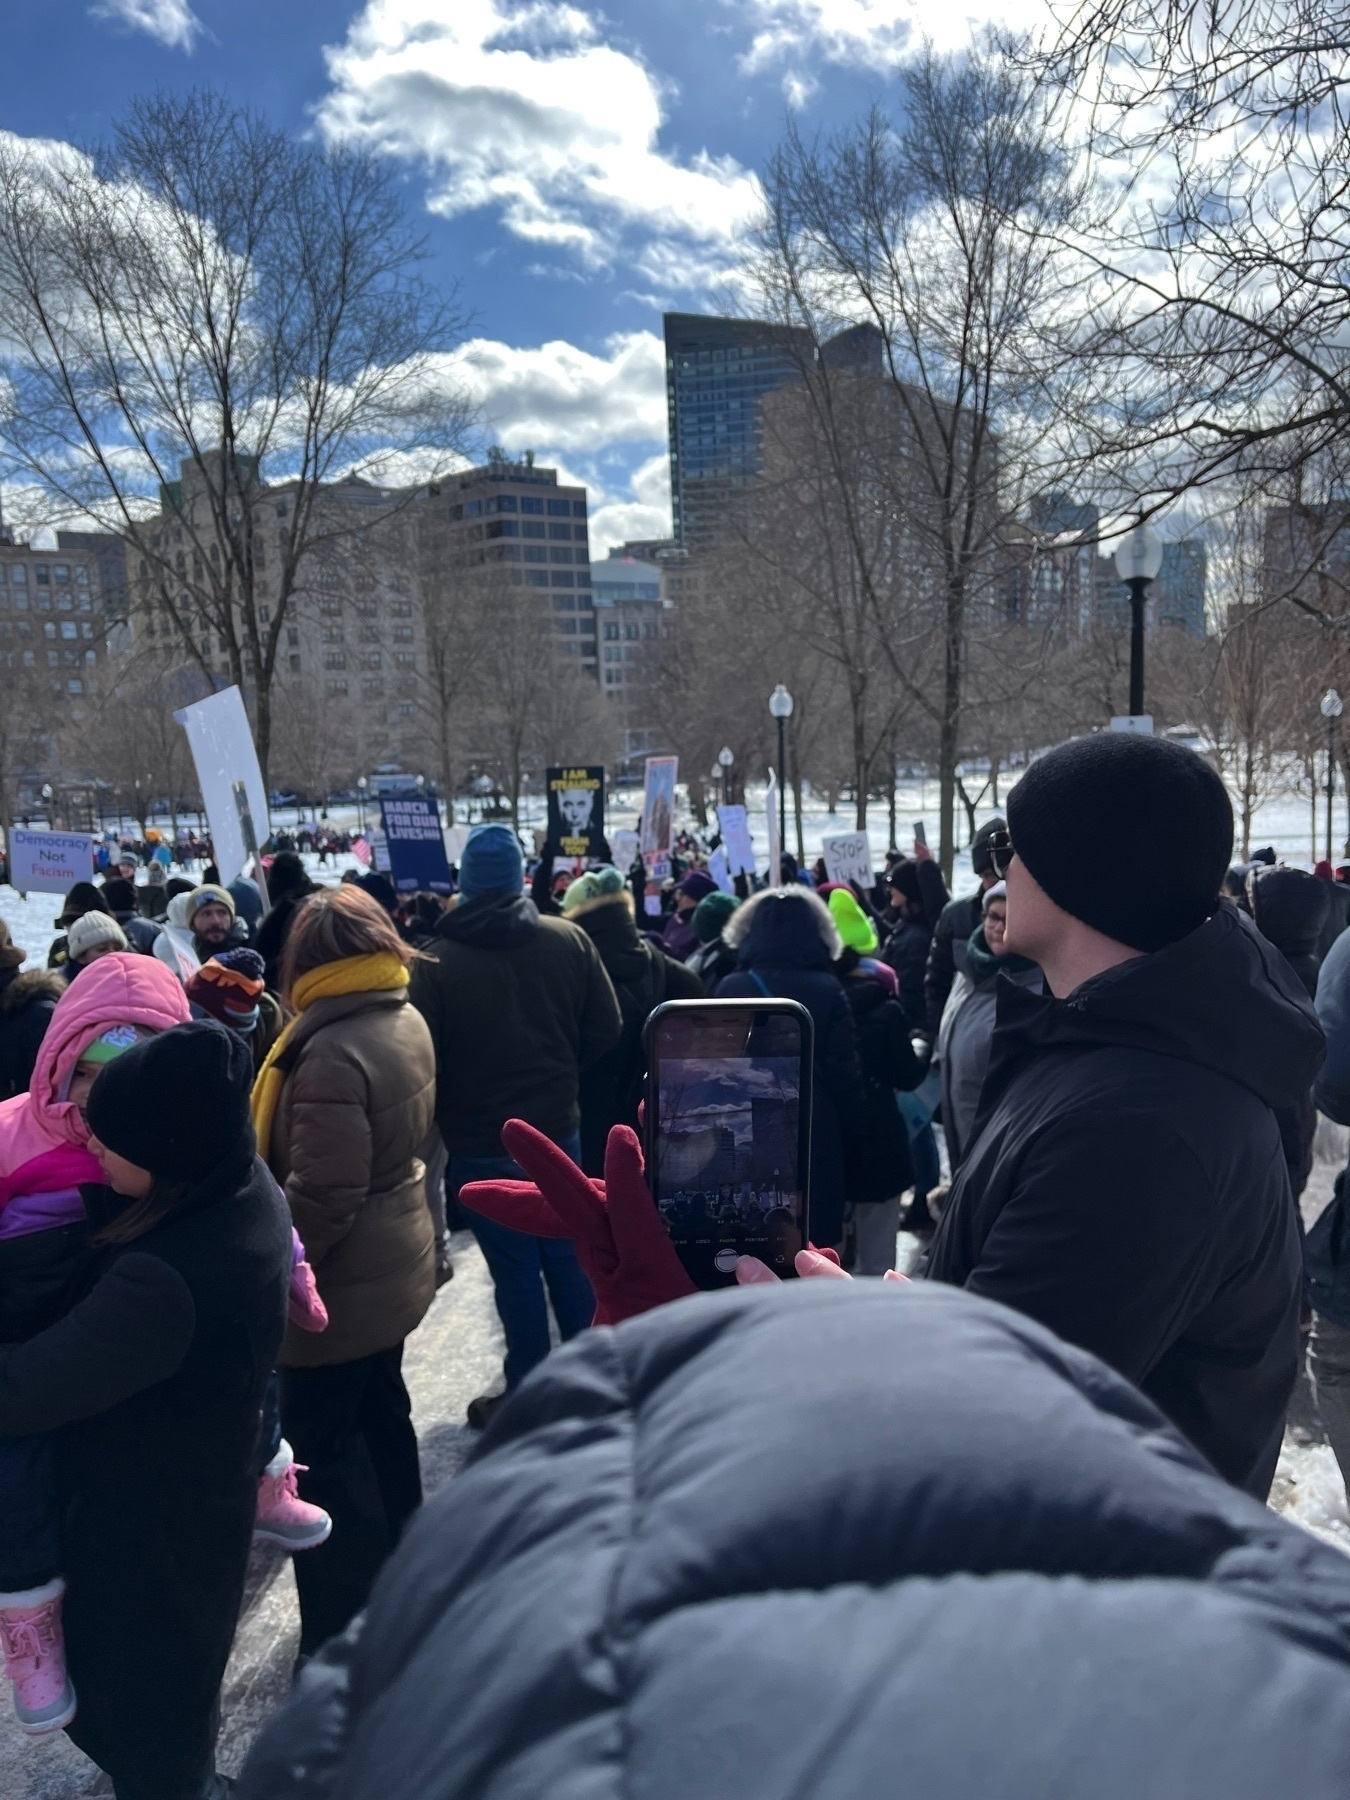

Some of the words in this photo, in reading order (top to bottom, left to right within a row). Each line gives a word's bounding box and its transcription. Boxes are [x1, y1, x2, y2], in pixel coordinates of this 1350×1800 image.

[569, 768, 587, 780] AM
[383, 801, 430, 814] MARCH
[385, 813, 411, 827] FOR
[411, 814, 439, 828] OUR
[388, 826, 424, 840] LIVES
[15, 831, 89, 852] Democracy
[39, 849, 67, 863] Not
[830, 839, 865, 863] STOP
[31, 863, 75, 879] Facism
